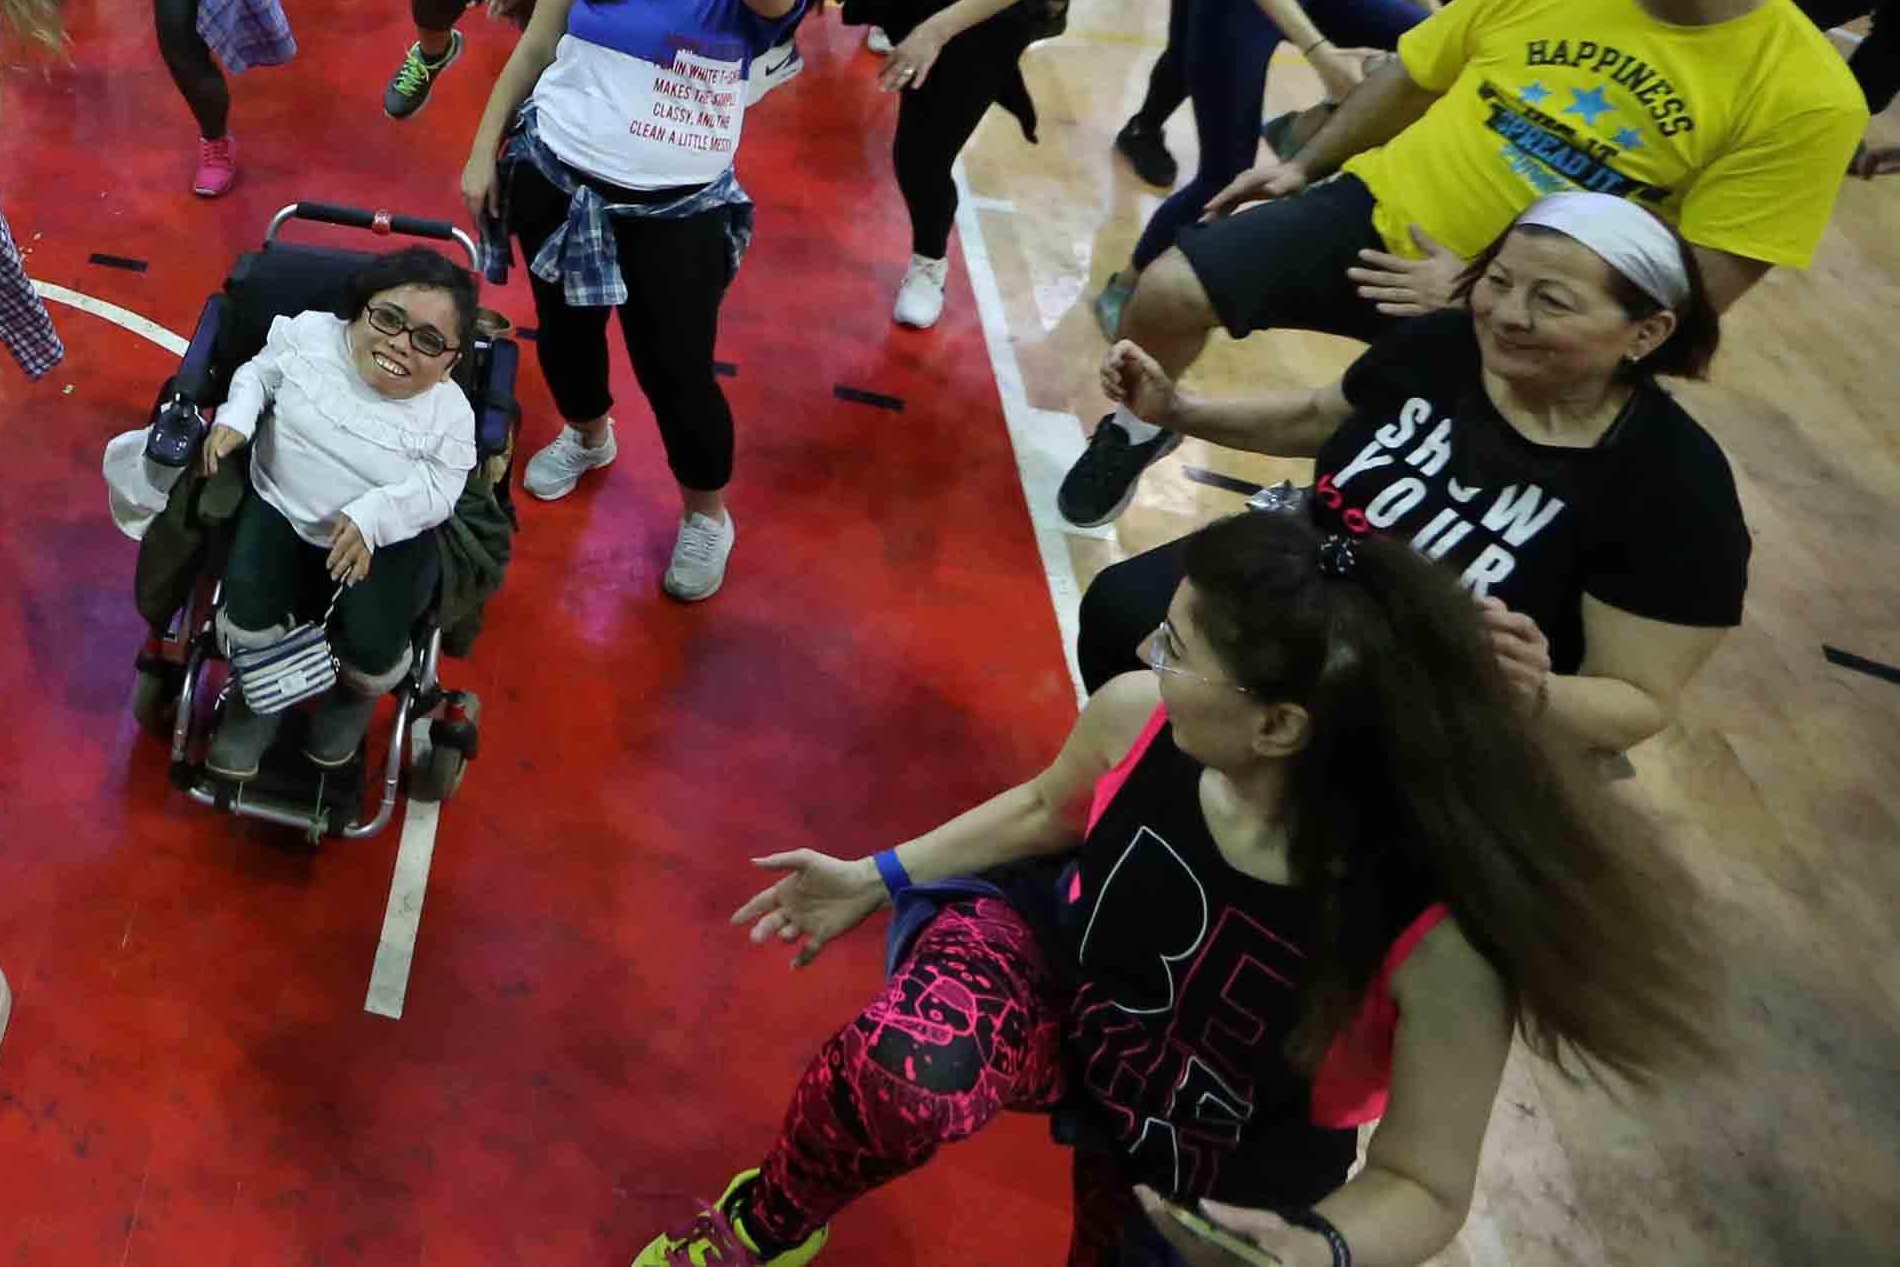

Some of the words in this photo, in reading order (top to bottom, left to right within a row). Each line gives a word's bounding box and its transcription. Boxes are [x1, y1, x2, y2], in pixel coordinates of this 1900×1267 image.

[653, 77, 692, 101] MAKES
[1526, 38, 1695, 138] HAPPINESS
[629, 119, 667, 142] CLEAN
[677, 132, 709, 151] LITTLE
